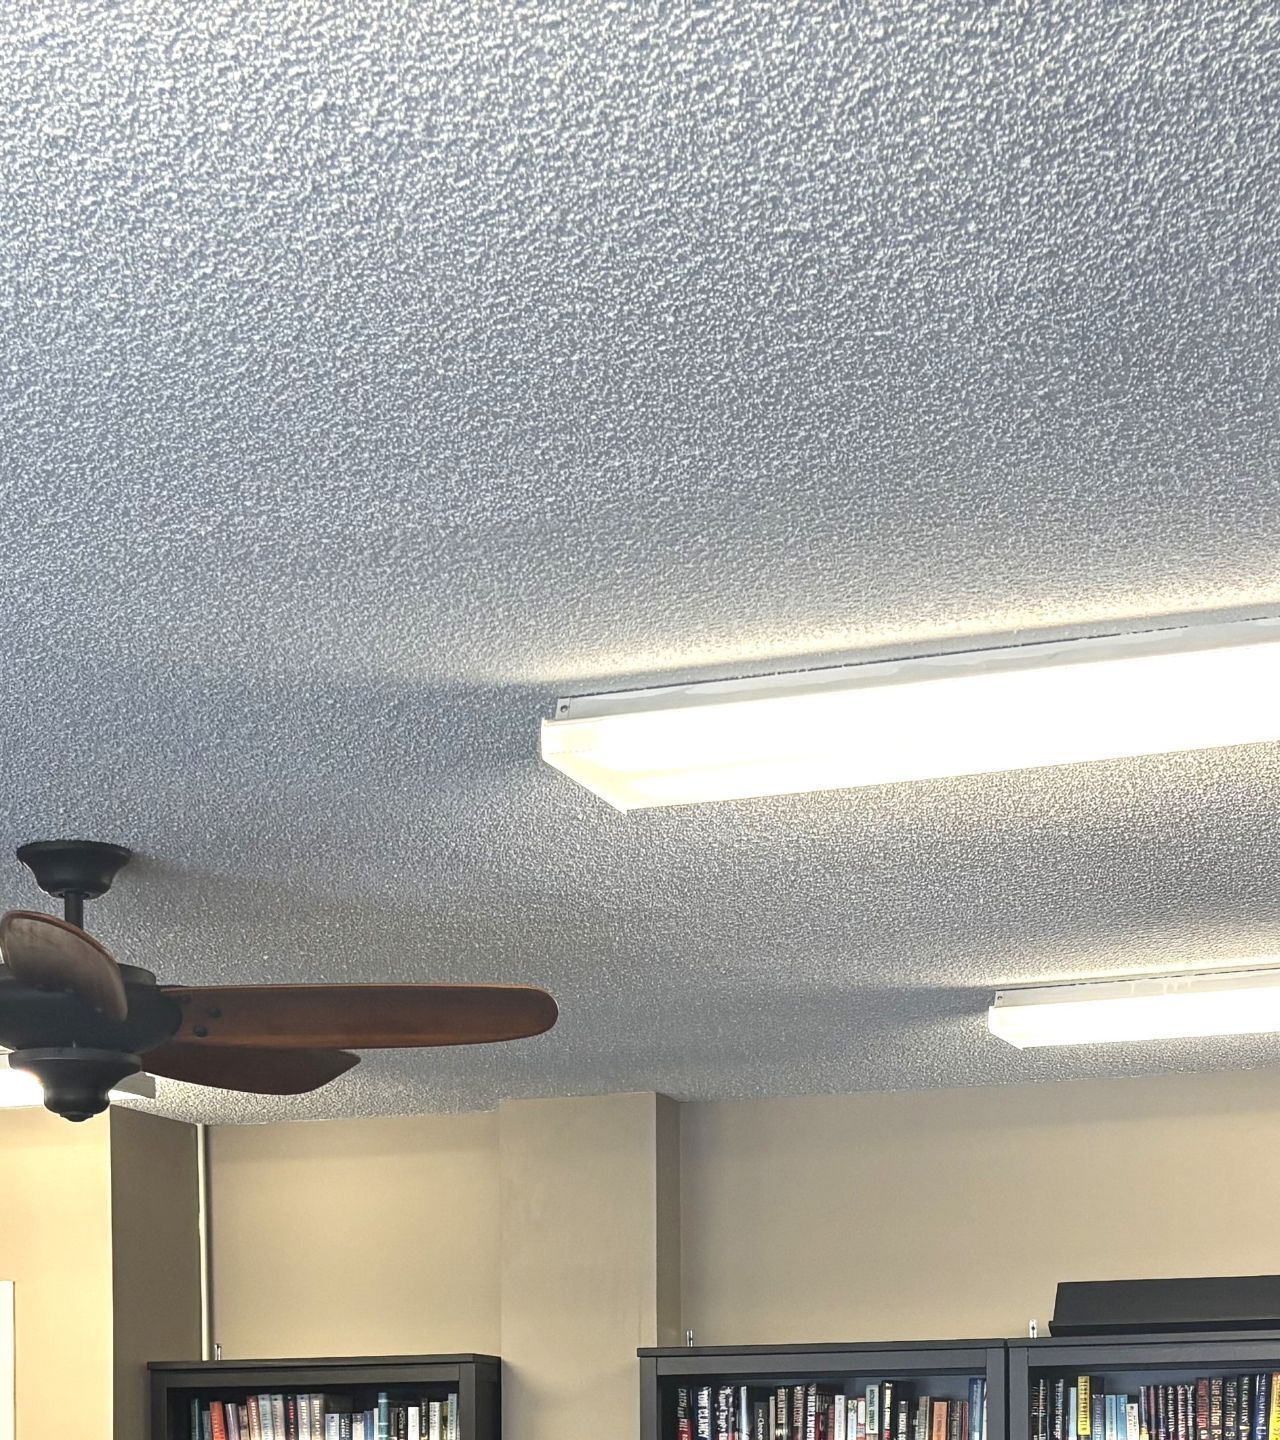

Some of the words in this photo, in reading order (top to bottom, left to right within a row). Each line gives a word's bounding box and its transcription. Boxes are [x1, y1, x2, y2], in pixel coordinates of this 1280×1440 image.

[678, 1388, 689, 1407] CATCH
[697, 1390, 709, 1408] TOM
[805, 1395, 816, 1428] HARLAN
[1198, 1395, 1210, 1429] Grafton
[1210, 1395, 1222, 1427] Grafton
[1225, 1396, 1238, 1428] Grafton
[1240, 1394, 1248, 1424] GRAFTON
[1258, 1394, 1267, 1424] GRAFTON
[697, 1409, 709, 1439] CLANCY
